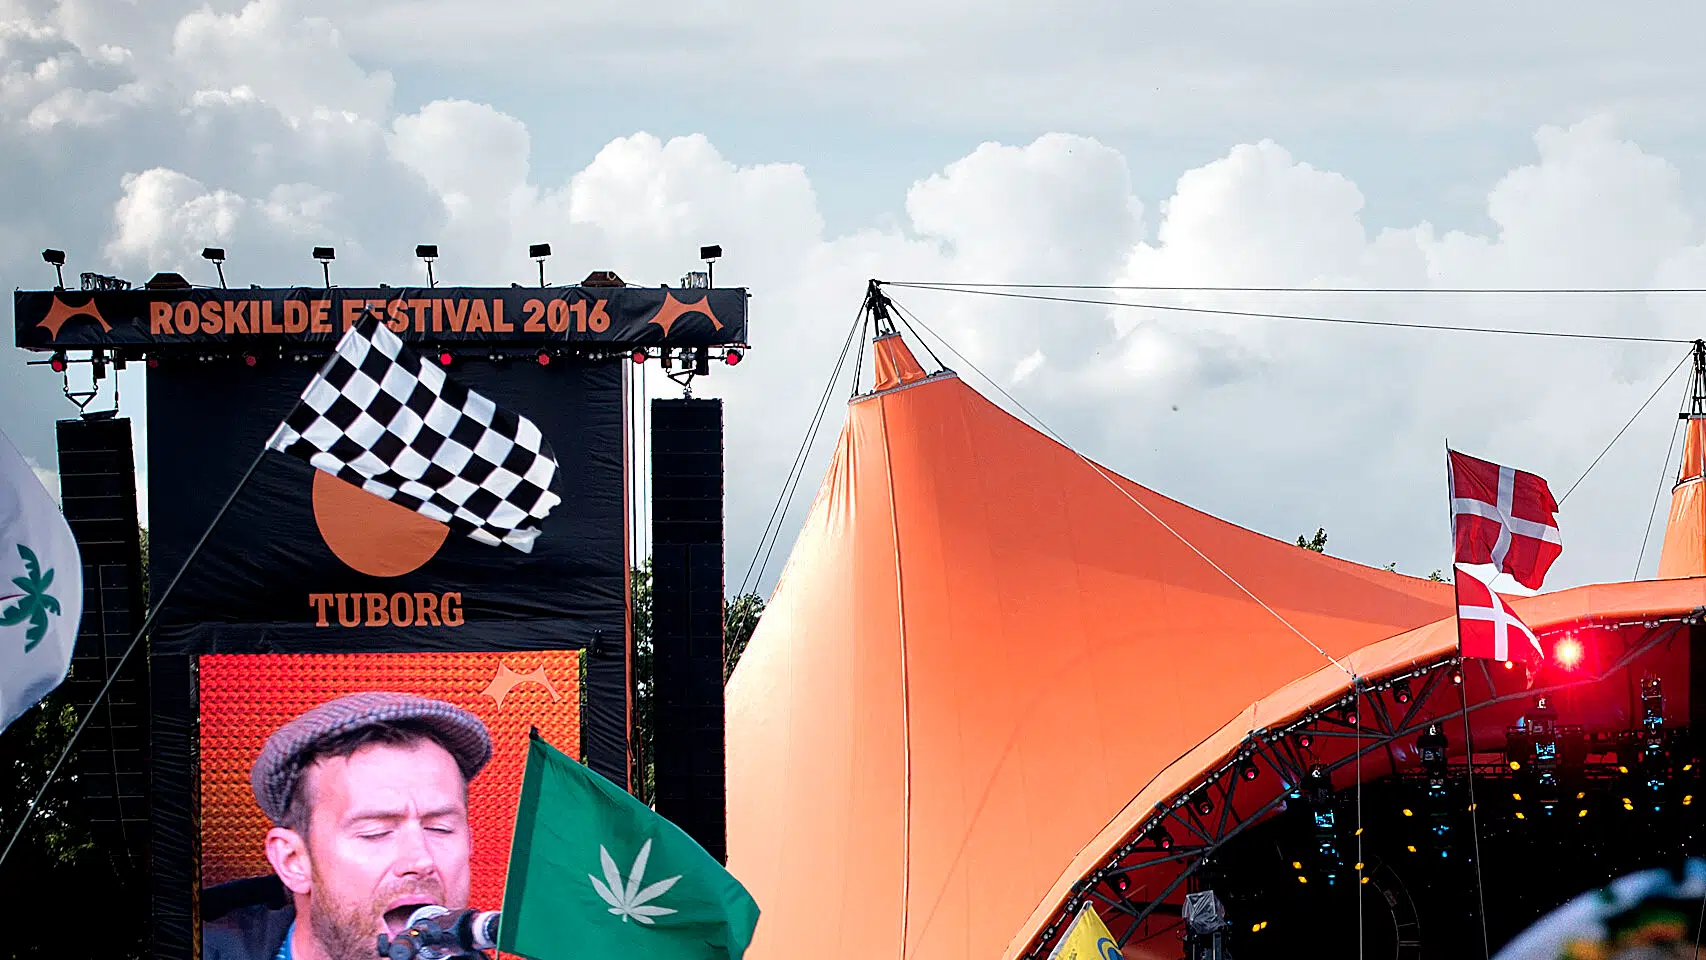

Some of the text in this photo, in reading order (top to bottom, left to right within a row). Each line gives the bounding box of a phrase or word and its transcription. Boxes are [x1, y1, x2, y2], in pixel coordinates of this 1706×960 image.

[150, 299, 333, 335] ROSKILDE
[522, 298, 611, 333] 2016
[308, 592, 465, 628] TUBORG
